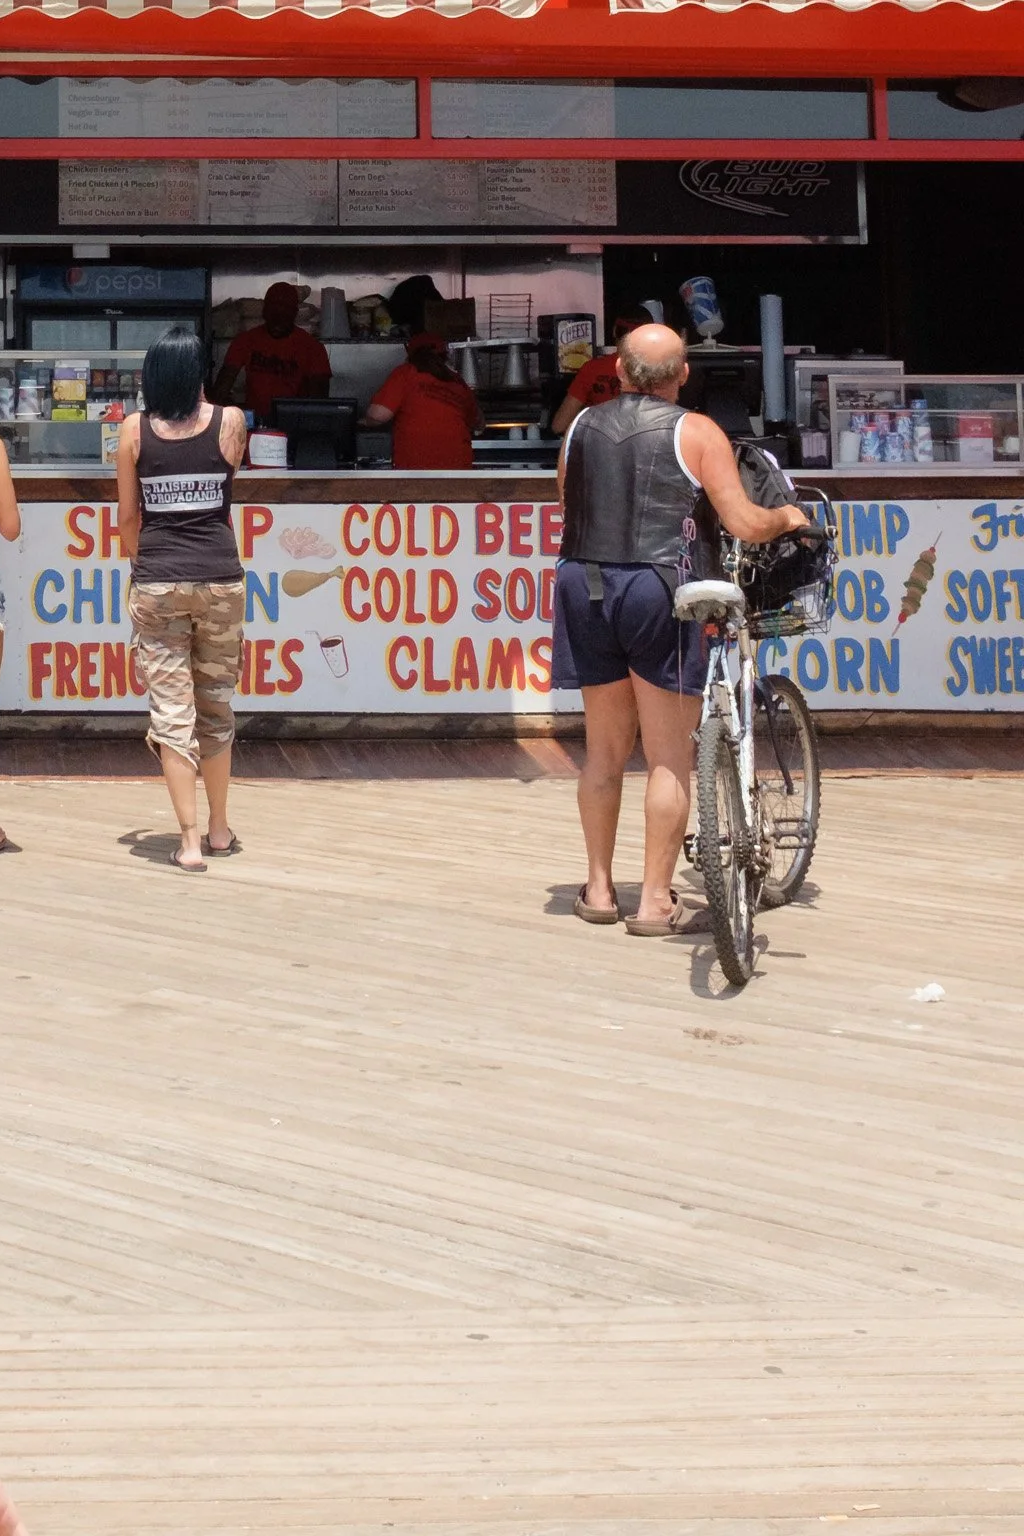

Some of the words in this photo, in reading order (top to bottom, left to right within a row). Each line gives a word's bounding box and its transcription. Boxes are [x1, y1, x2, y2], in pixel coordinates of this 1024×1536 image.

[348, 173, 365, 182] Corn
[367, 173, 386, 182] Dogs
[724, 160, 827, 176] BUD
[68, 180, 87, 188] Fried
[88, 180, 119, 188] Chicken
[699, 173, 831, 196] LIGHT
[68, 209, 93, 217] Grilled
[95, 209, 125, 217] Chicken
[126, 209, 135, 217] on
[144, 209, 159, 217] Bun
[96, 271, 163, 295] pepsi
[561, 325, 591, 344] CHEESE
[151, 489, 224, 504] PROPAGANDA
[152, 481, 195, 493] RAISED
[197, 480, 222, 491] FIST
[65, 505, 274, 560] SHP
[341, 504, 460, 556] COLD
[473, 503, 564, 557] BEE
[31, 568, 279, 625] CHIN
[340, 566, 459, 625] COLD
[472, 567, 556, 623] SOD
[28, 641, 149, 699] FRENC
[385, 635, 553, 695] CLAMS
[755, 636, 901, 695] CORN
